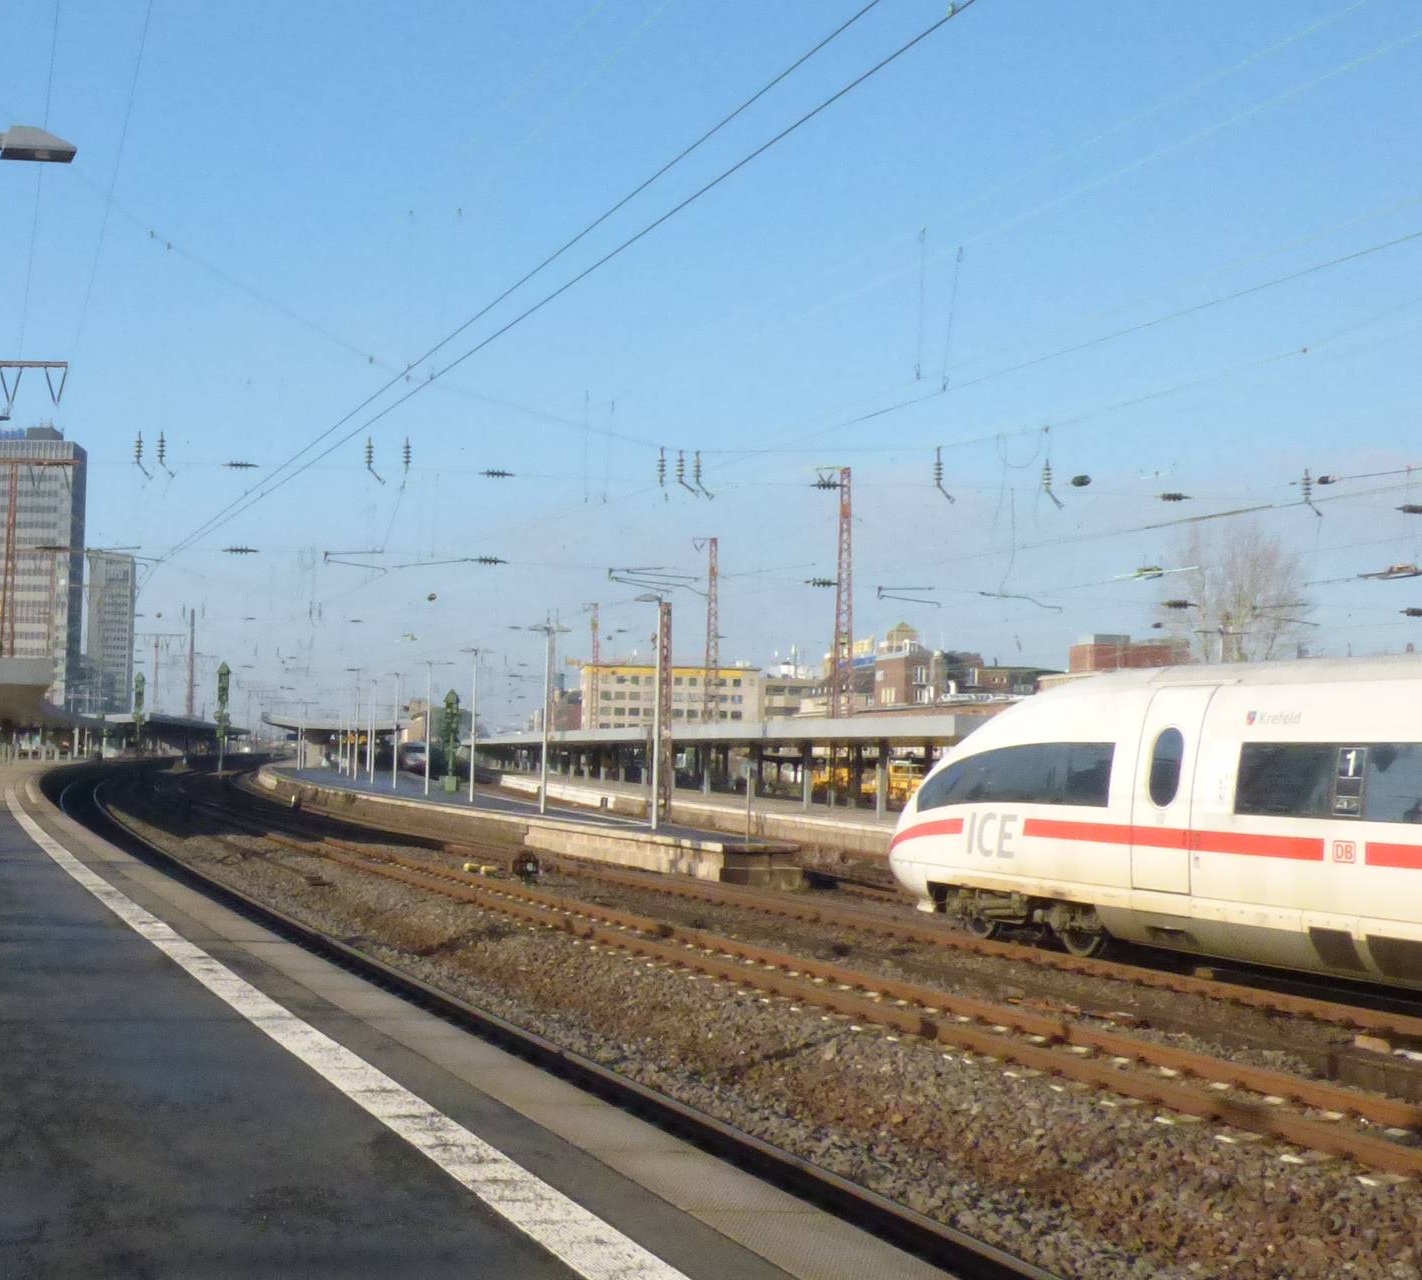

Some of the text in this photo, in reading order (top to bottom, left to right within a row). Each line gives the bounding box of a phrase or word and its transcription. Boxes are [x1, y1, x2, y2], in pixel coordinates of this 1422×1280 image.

[1259, 711, 1302, 725] Krefeld
[1346, 750, 1356, 776] 1
[967, 811, 1018, 859] ICE
[1335, 843, 1354, 861] DB
